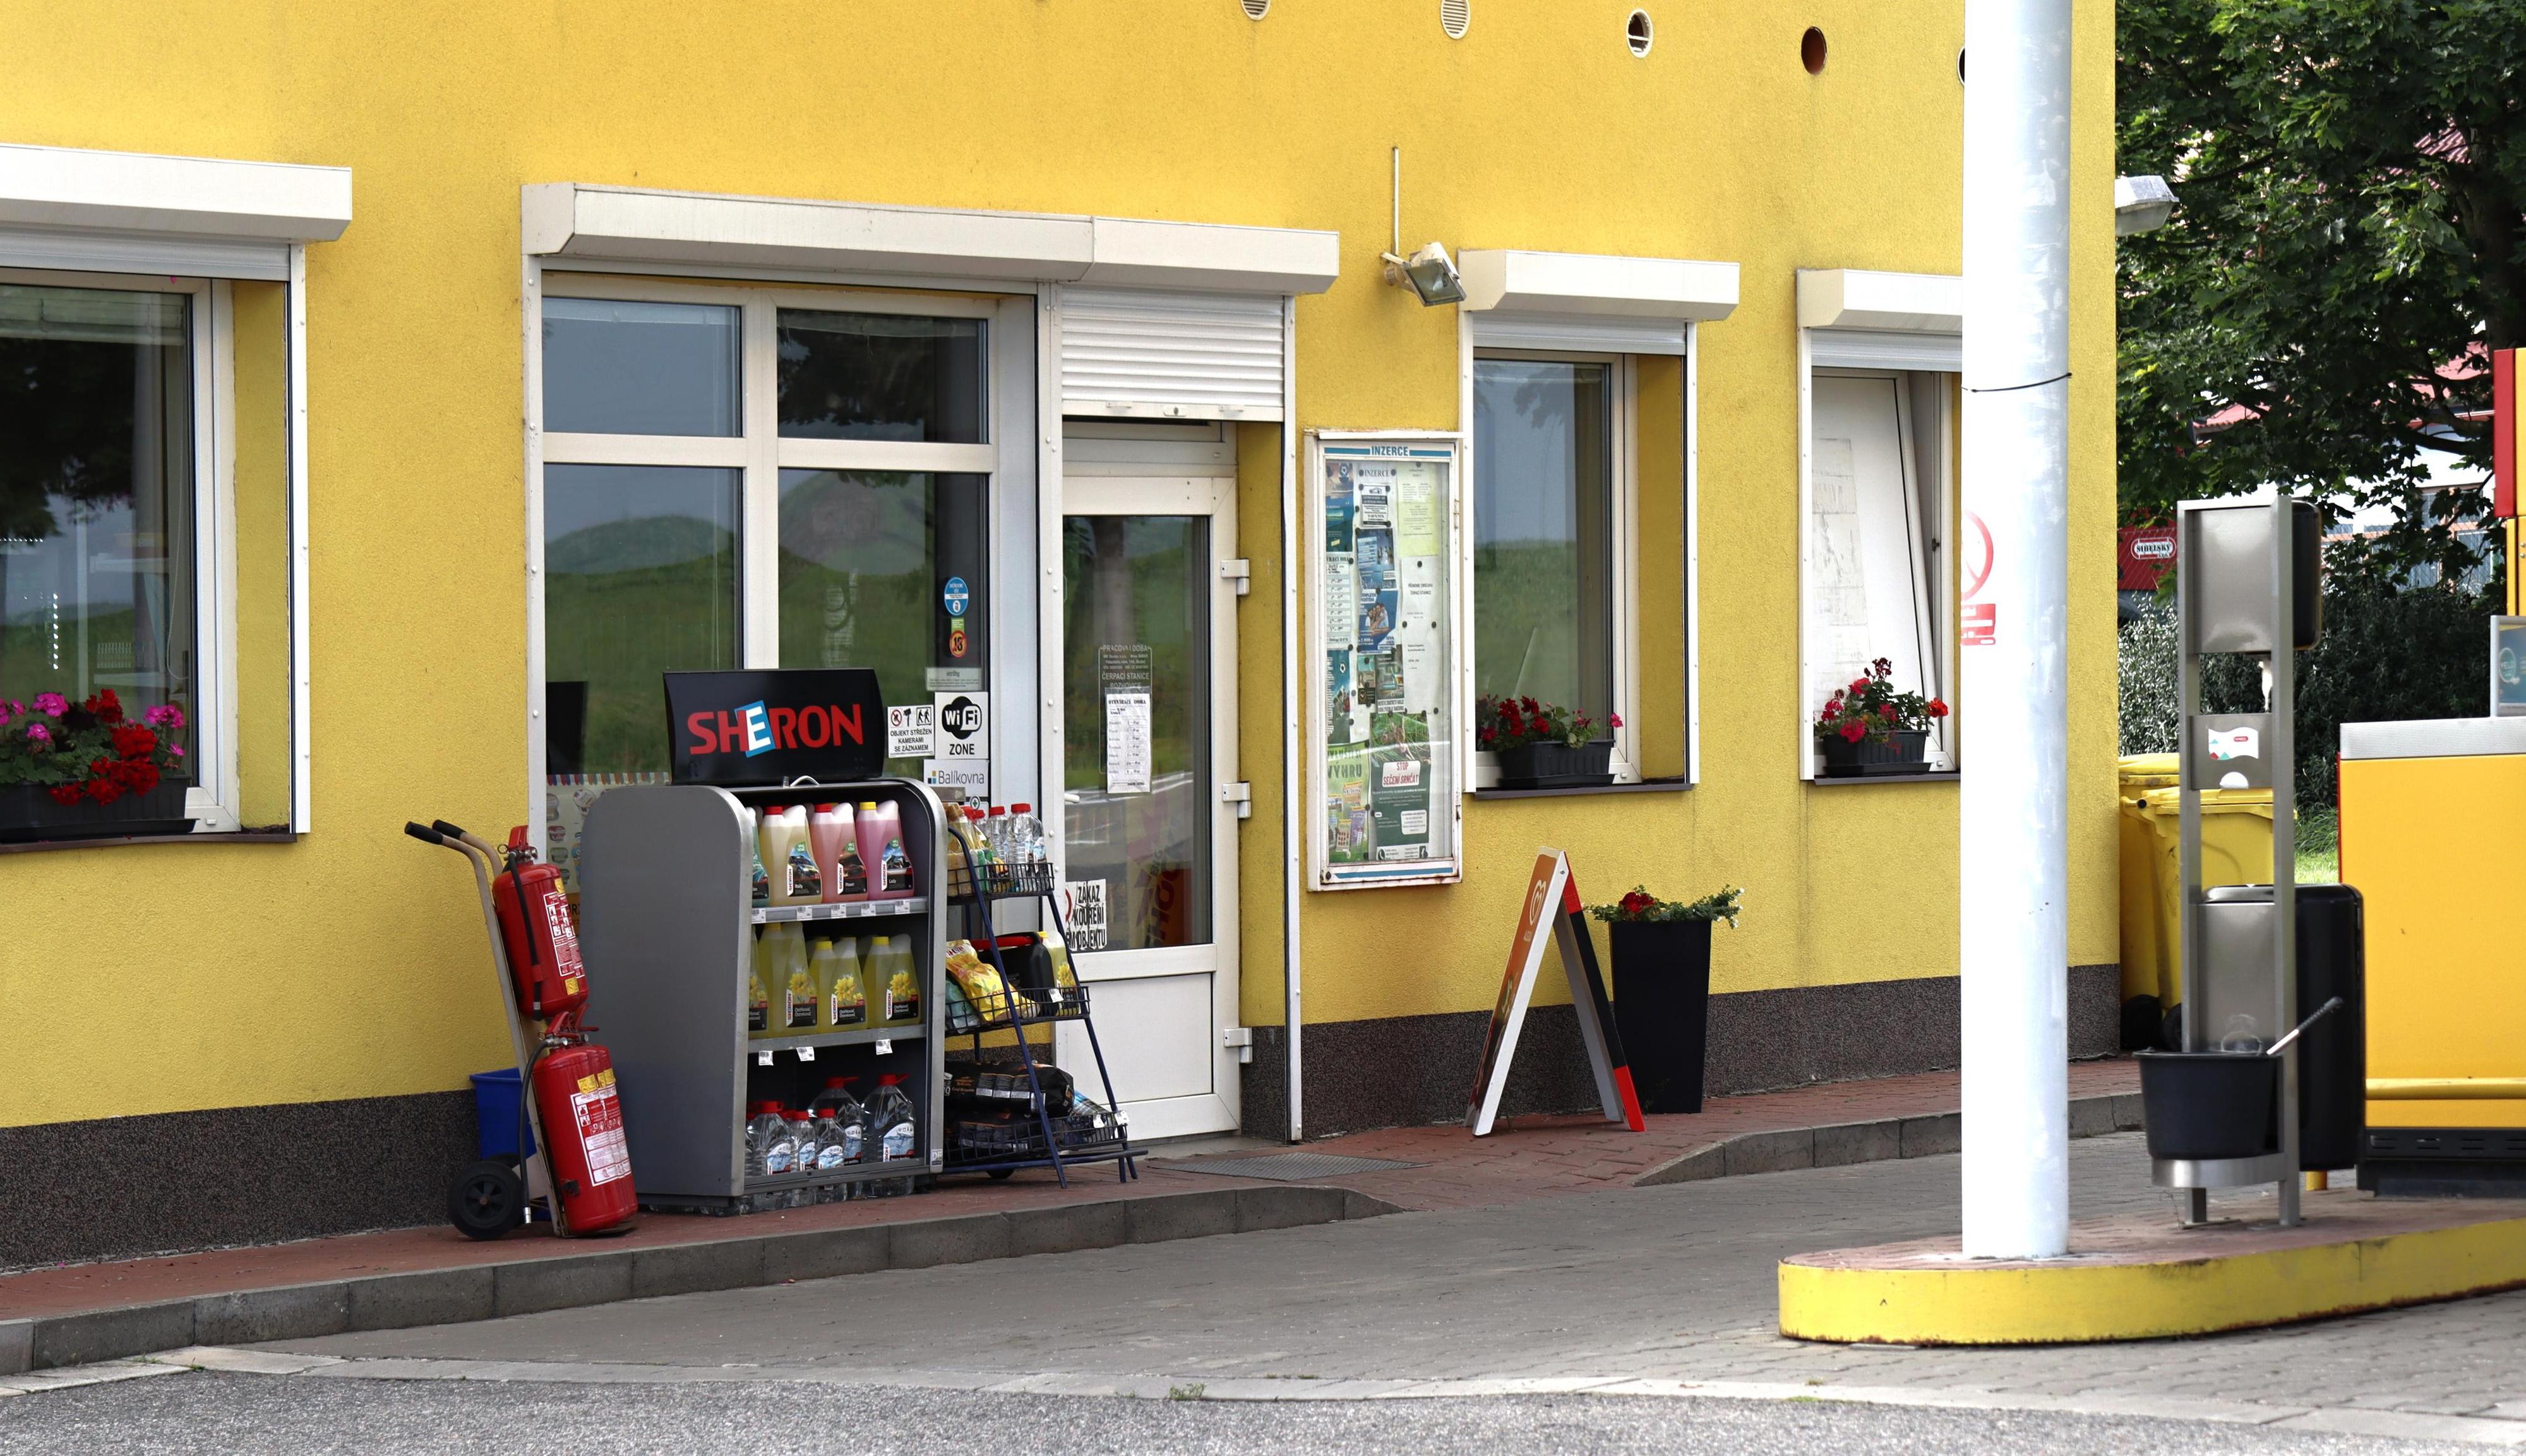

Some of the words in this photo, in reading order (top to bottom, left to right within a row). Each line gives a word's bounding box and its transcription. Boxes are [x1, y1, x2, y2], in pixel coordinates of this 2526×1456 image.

[1371, 445, 1409, 456] INZERCE
[1364, 469, 1389, 477] INZERCE
[953, 636, 963, 652] 18
[1101, 671, 1126, 680] ČERPACÍ
[687, 702, 864, 756] SHERON
[902, 743, 929, 751] ZÁZNAMEM
[949, 744, 975, 755] ZONE
[1327, 762, 1362, 778] VÝHRU
[1396, 761, 1409, 771] STOP
[938, 770, 985, 784] Balíkovna
[1383, 773, 1400, 785] SEČENÍ
[1400, 772, 1419, 784] SRNČAT
[1078, 883, 1100, 904] ZÁKAZ
[1074, 903, 1104, 926] KOUŘENÍ
[1076, 929, 1106, 948] OBJEKTU
